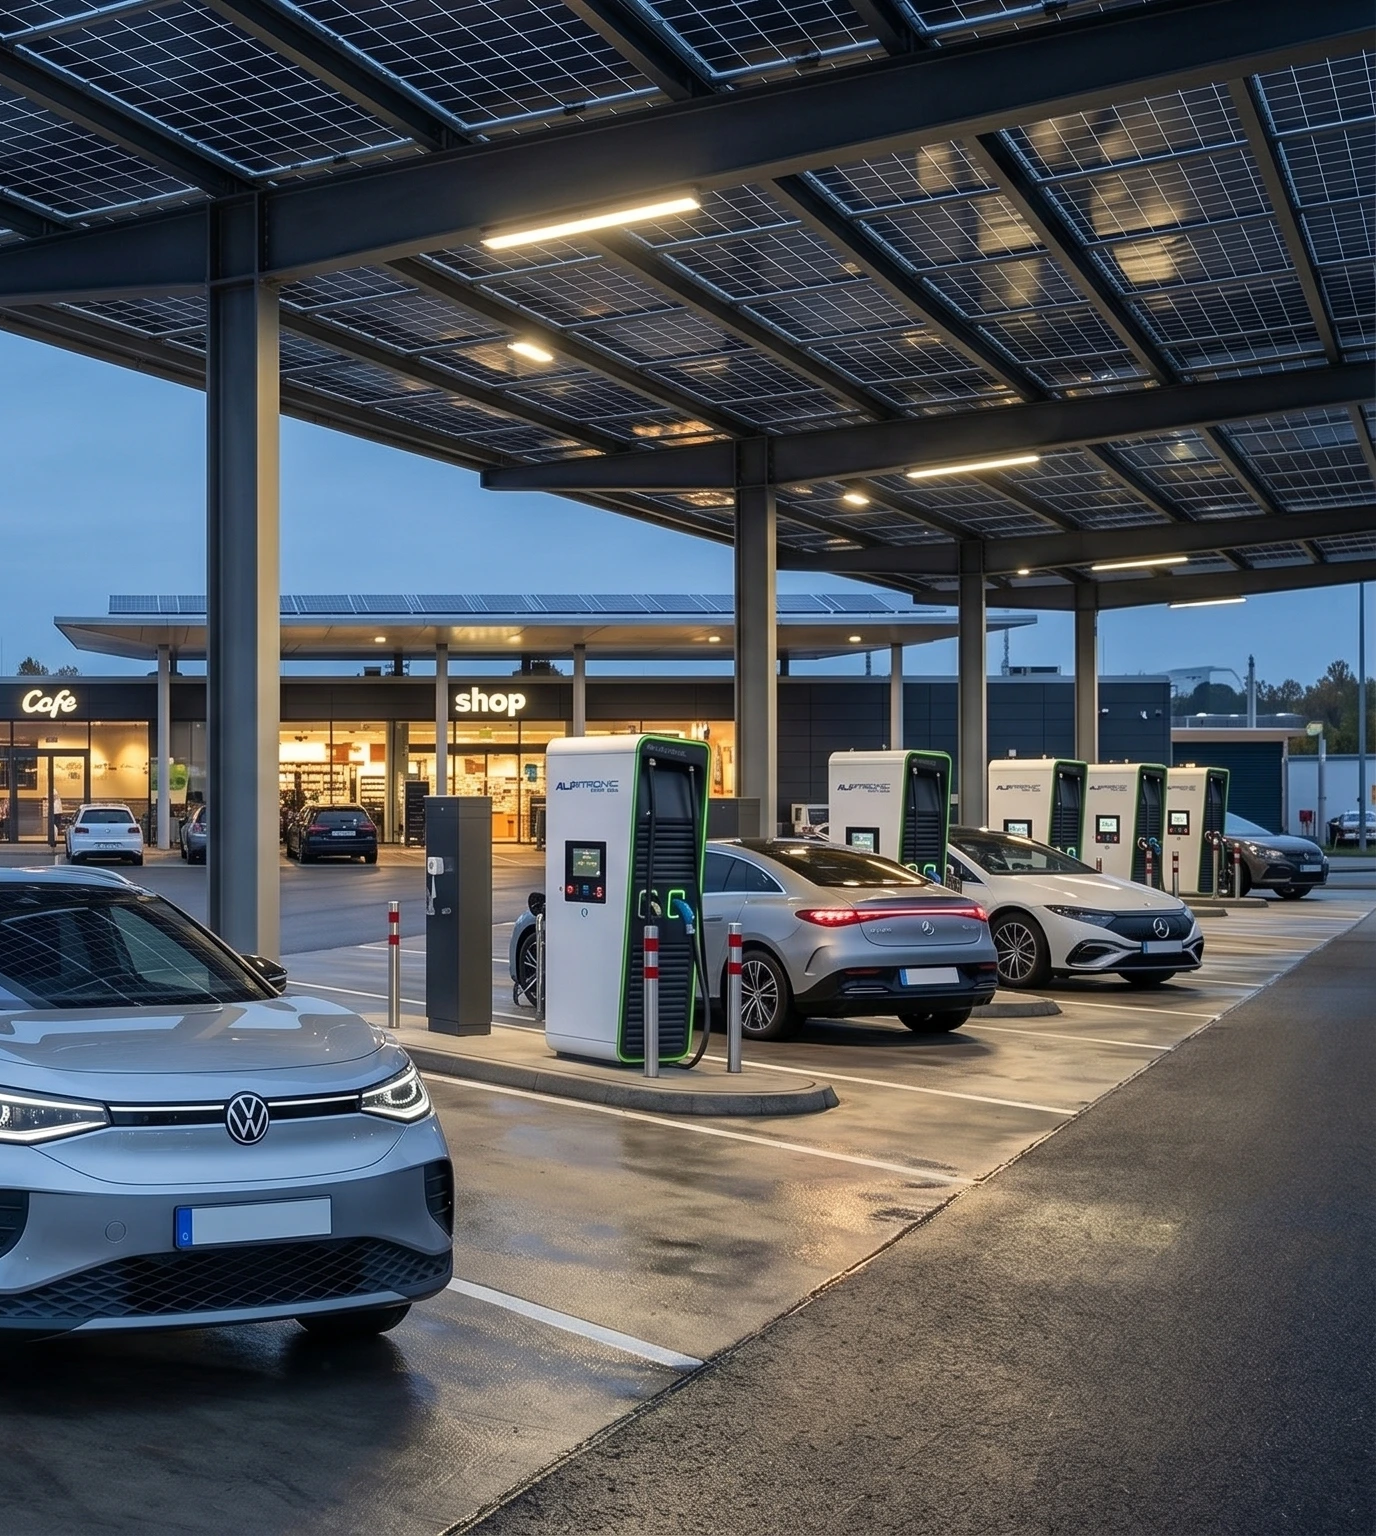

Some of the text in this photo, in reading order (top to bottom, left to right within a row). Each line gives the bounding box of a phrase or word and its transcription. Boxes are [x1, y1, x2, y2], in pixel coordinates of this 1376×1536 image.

[22, 689, 78, 718] Cafe
[455, 687, 526, 717] shop
[227, 1094, 269, 1143] VW
